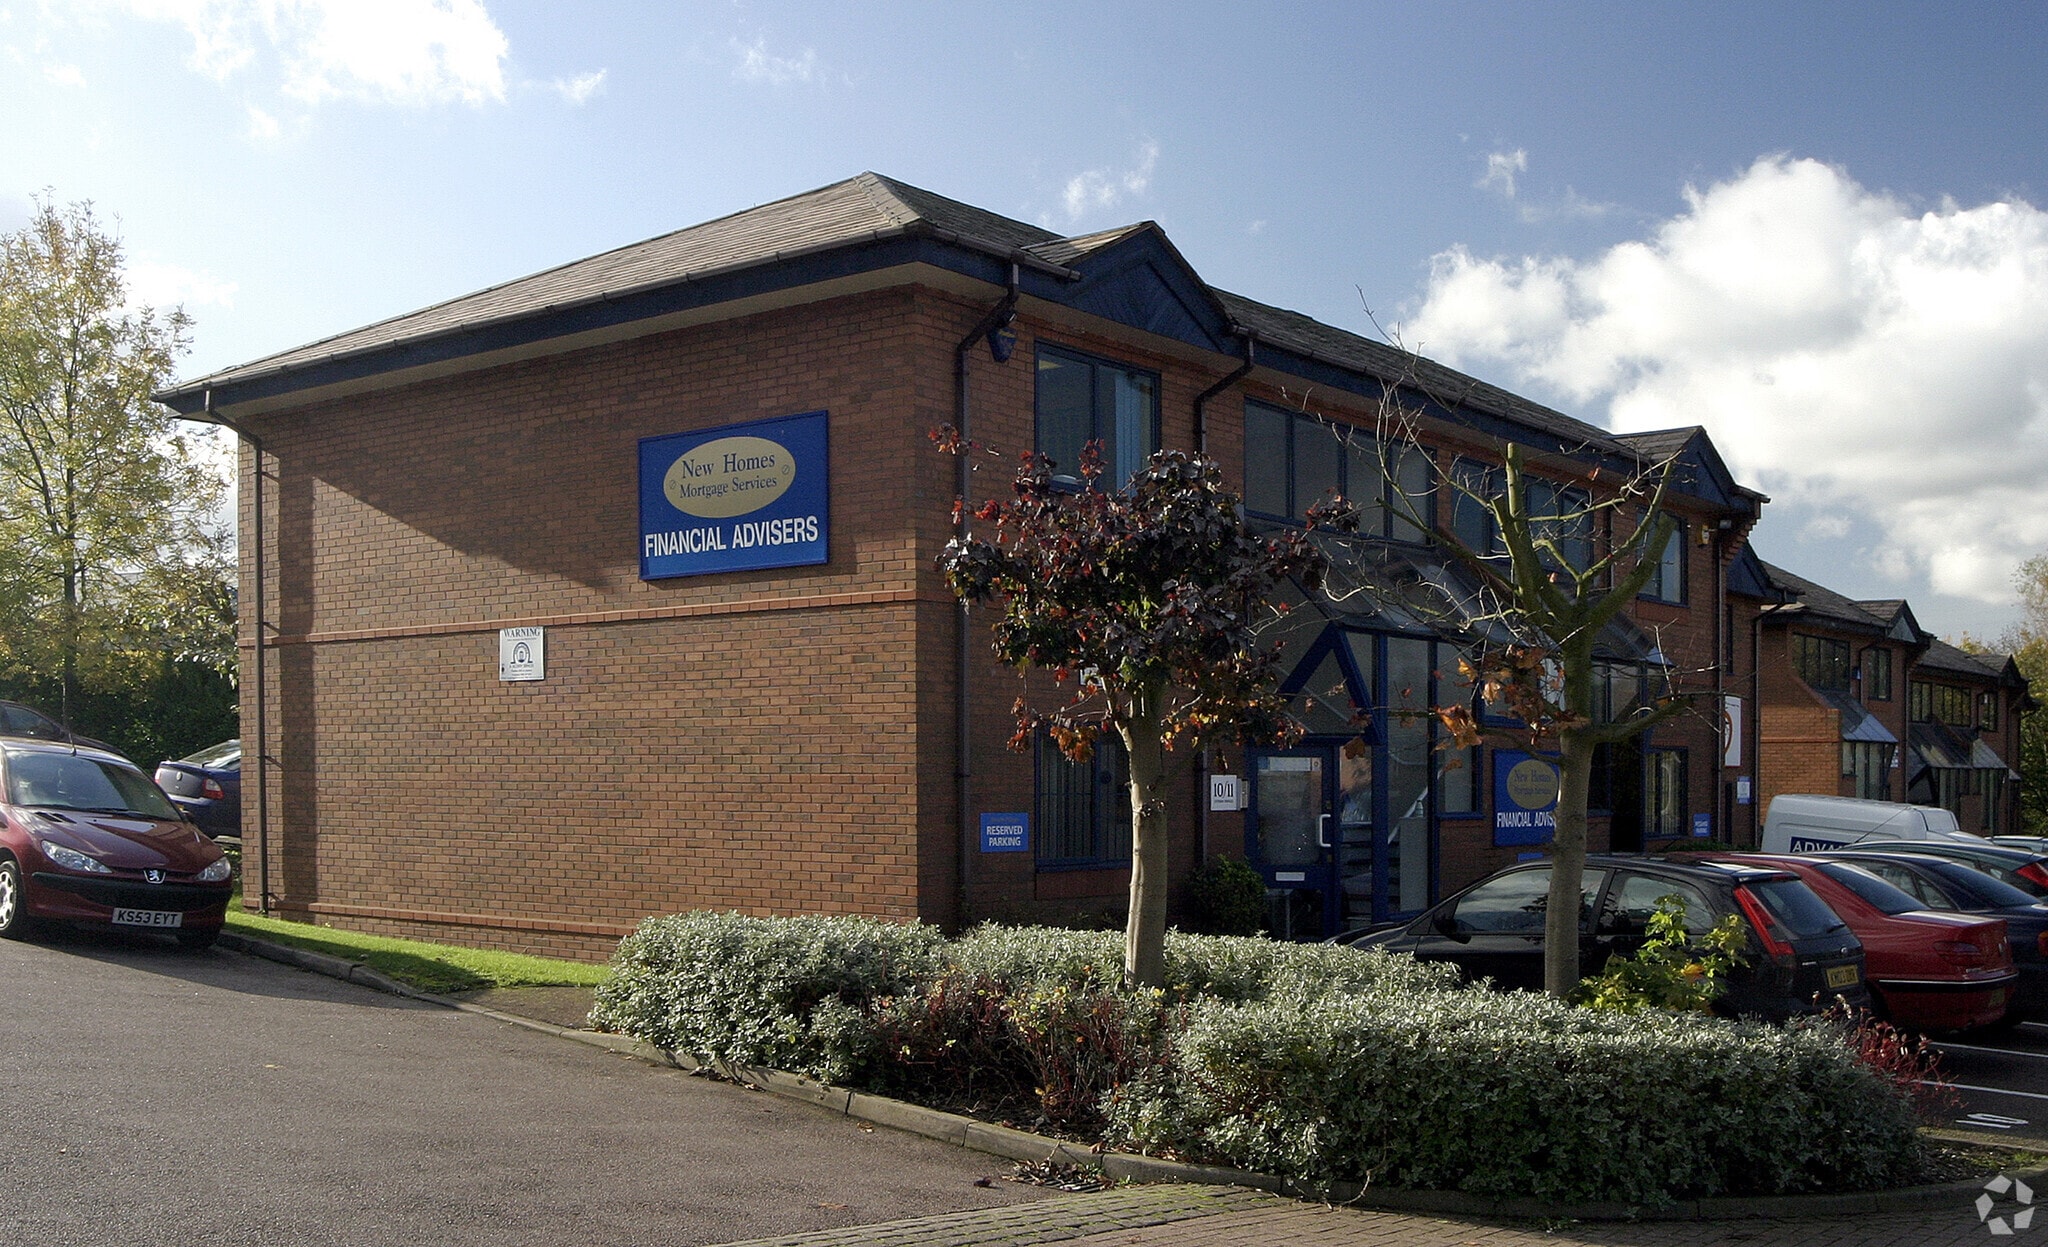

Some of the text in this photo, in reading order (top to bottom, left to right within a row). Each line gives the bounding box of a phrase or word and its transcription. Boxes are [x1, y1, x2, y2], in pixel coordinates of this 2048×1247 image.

[682, 453, 775, 479] New Homes
[680, 475, 777, 499] Mortgage Services
[645, 515, 818, 557] FINANCIAL ADVISERS
[503, 626, 540, 638] WARNING
[1214, 781, 1234, 798] 10/11
[1496, 811, 1555, 828] FINANCIAL ADVIS
[986, 825, 1023, 835] RESERVED
[989, 836, 1021, 847] PARKING
[1792, 840, 1843, 852] ADVA
[117, 910, 178, 925] KS53 EYT
